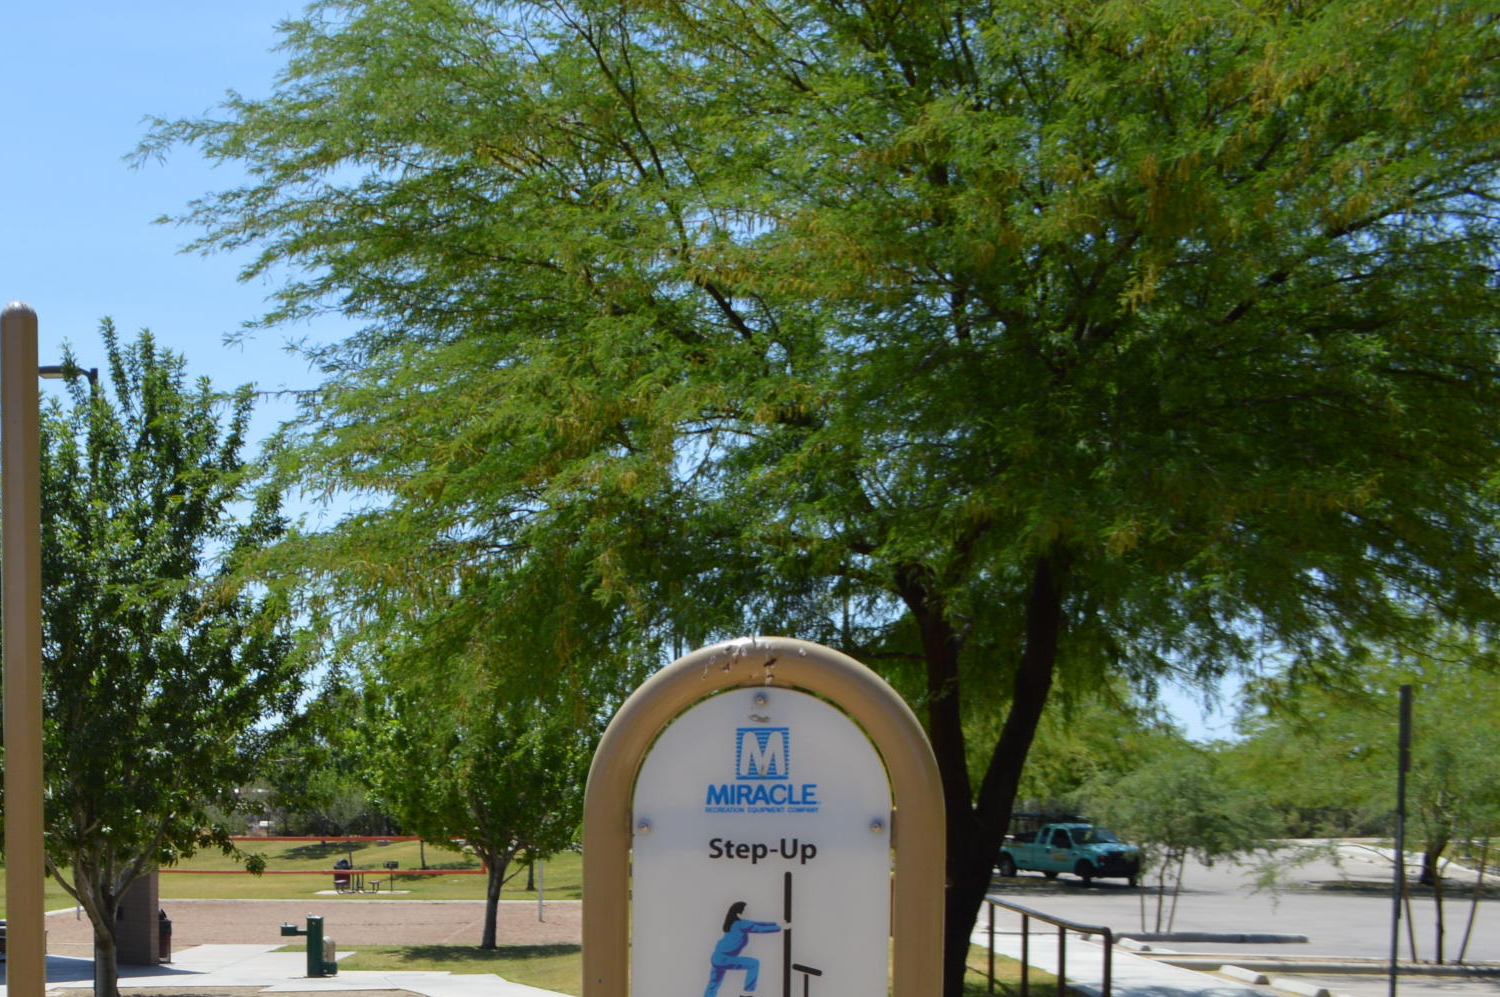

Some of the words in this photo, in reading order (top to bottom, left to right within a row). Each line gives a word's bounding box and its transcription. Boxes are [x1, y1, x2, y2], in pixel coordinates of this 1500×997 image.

[739, 730, 787, 777] M
[706, 784, 818, 806] MIRACLE
[709, 838, 817, 865] Step-Up
